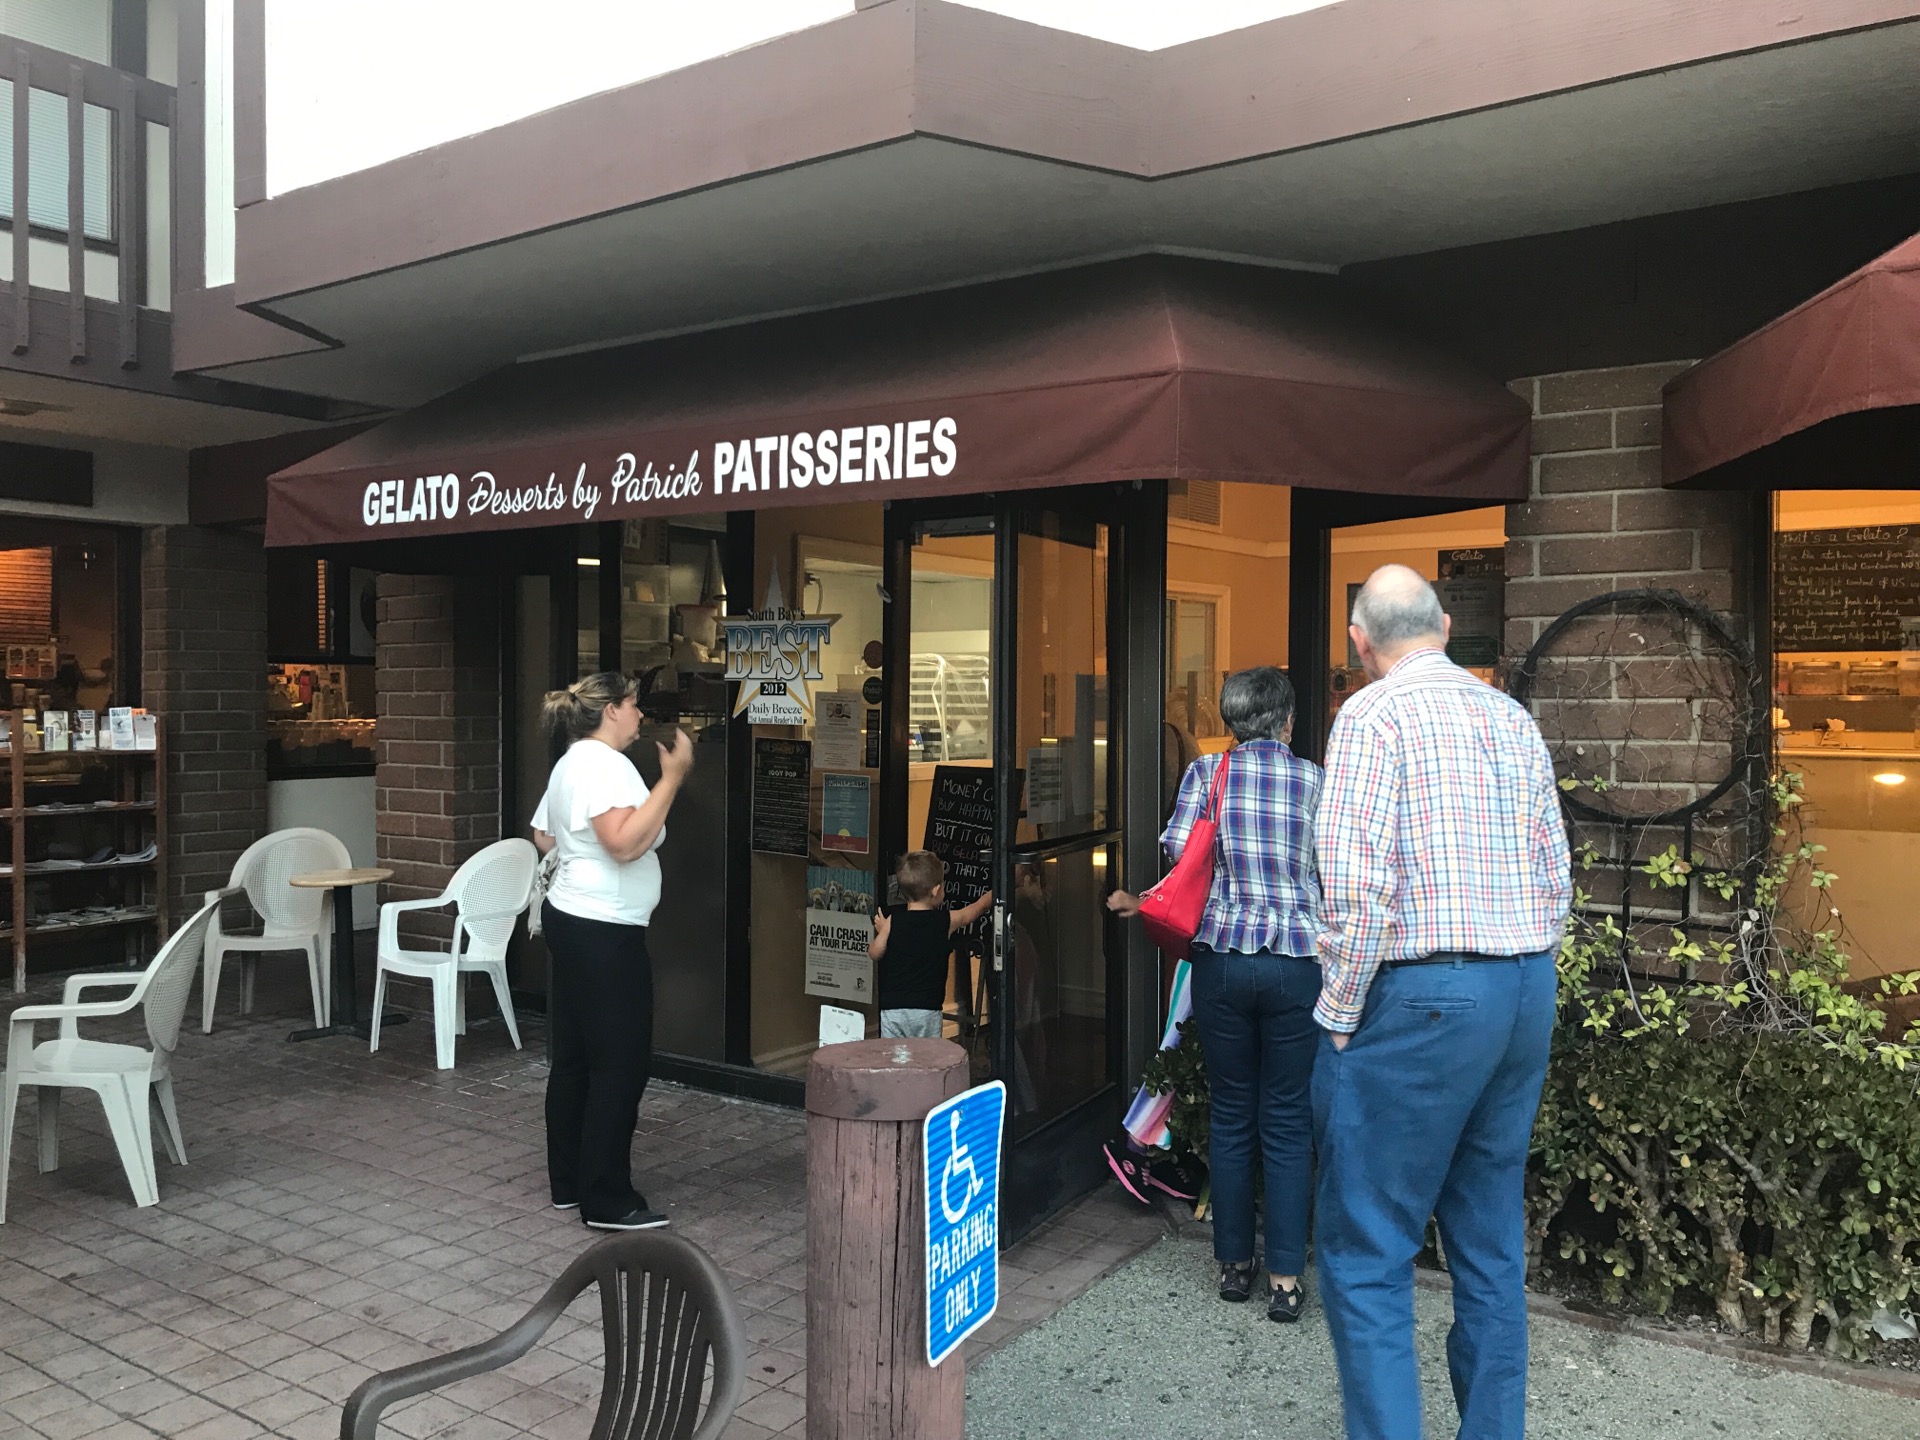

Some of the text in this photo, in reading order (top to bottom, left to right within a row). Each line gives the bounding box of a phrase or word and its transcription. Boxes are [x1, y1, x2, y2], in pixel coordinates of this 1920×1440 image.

[362, 416, 957, 526] GELATO Desserts by Patrick PATISSERIES
[1846, 526, 1890, 541] Gelato
[1451, 549, 1486, 561] Gelato
[1891, 577, 1906, 588] US
[746, 607, 806, 624] South Bay's
[724, 623, 830, 681] BEST
[763, 683, 785, 695] 2012
[111, 708, 131, 717] SURF
[748, 702, 803, 716] Daily Breeze
[794, 716, 803, 724] Poll
[768, 769, 797, 778] IGGY POP
[942, 778, 980, 799] MONEY
[938, 798, 956, 812] BUY
[934, 822, 993, 847] BUT IT CAN
[932, 839, 950, 854] BUY
[953, 862, 990, 881] THAT'S
[810, 923, 868, 942] CAN I CRASH
[809, 936, 870, 952] AT YOUR PLACE?
[931, 1203, 993, 1290] PARKING
[945, 1265, 981, 1334] ONLY
